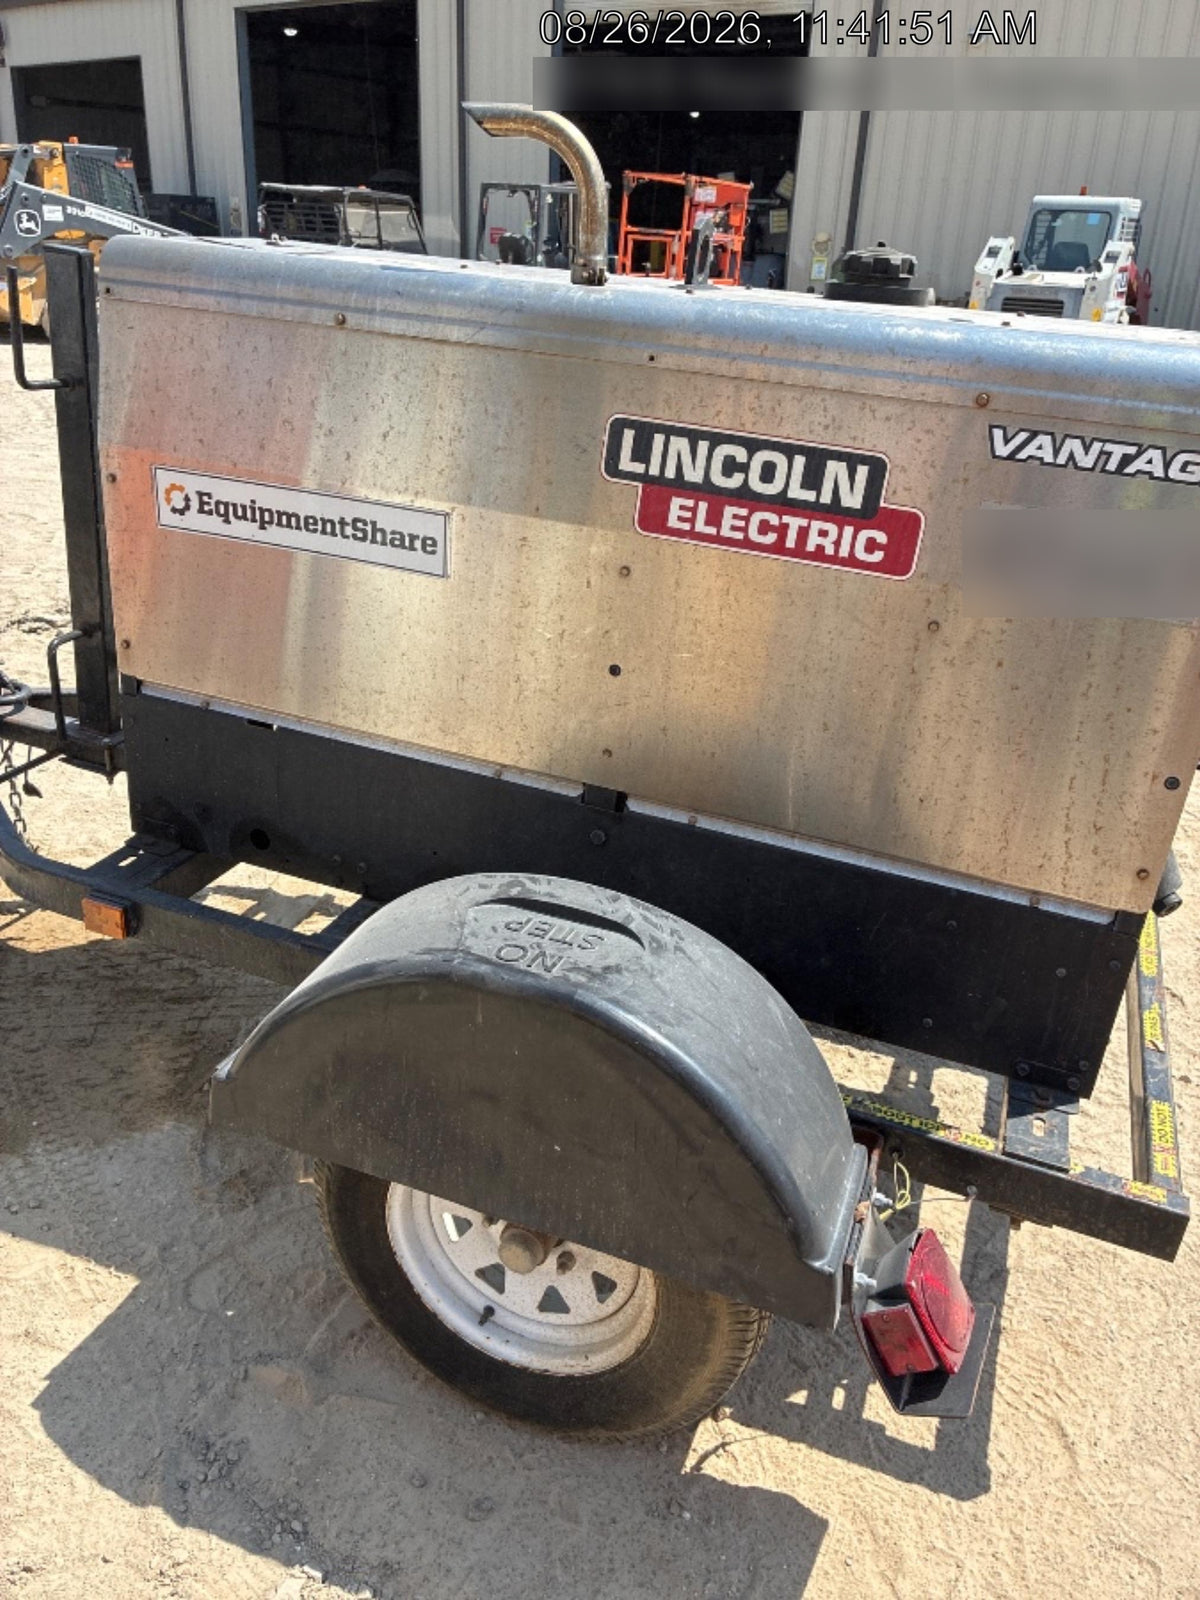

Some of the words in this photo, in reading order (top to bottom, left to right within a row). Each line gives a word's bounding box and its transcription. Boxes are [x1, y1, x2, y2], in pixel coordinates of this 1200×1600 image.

[618, 428, 870, 509] LINCOLN
[196, 490, 438, 555] EquipmentShare
[667, 496, 888, 563] ELECTRIC
[495, 943, 567, 974] NO
[504, 917, 607, 951] STEP
